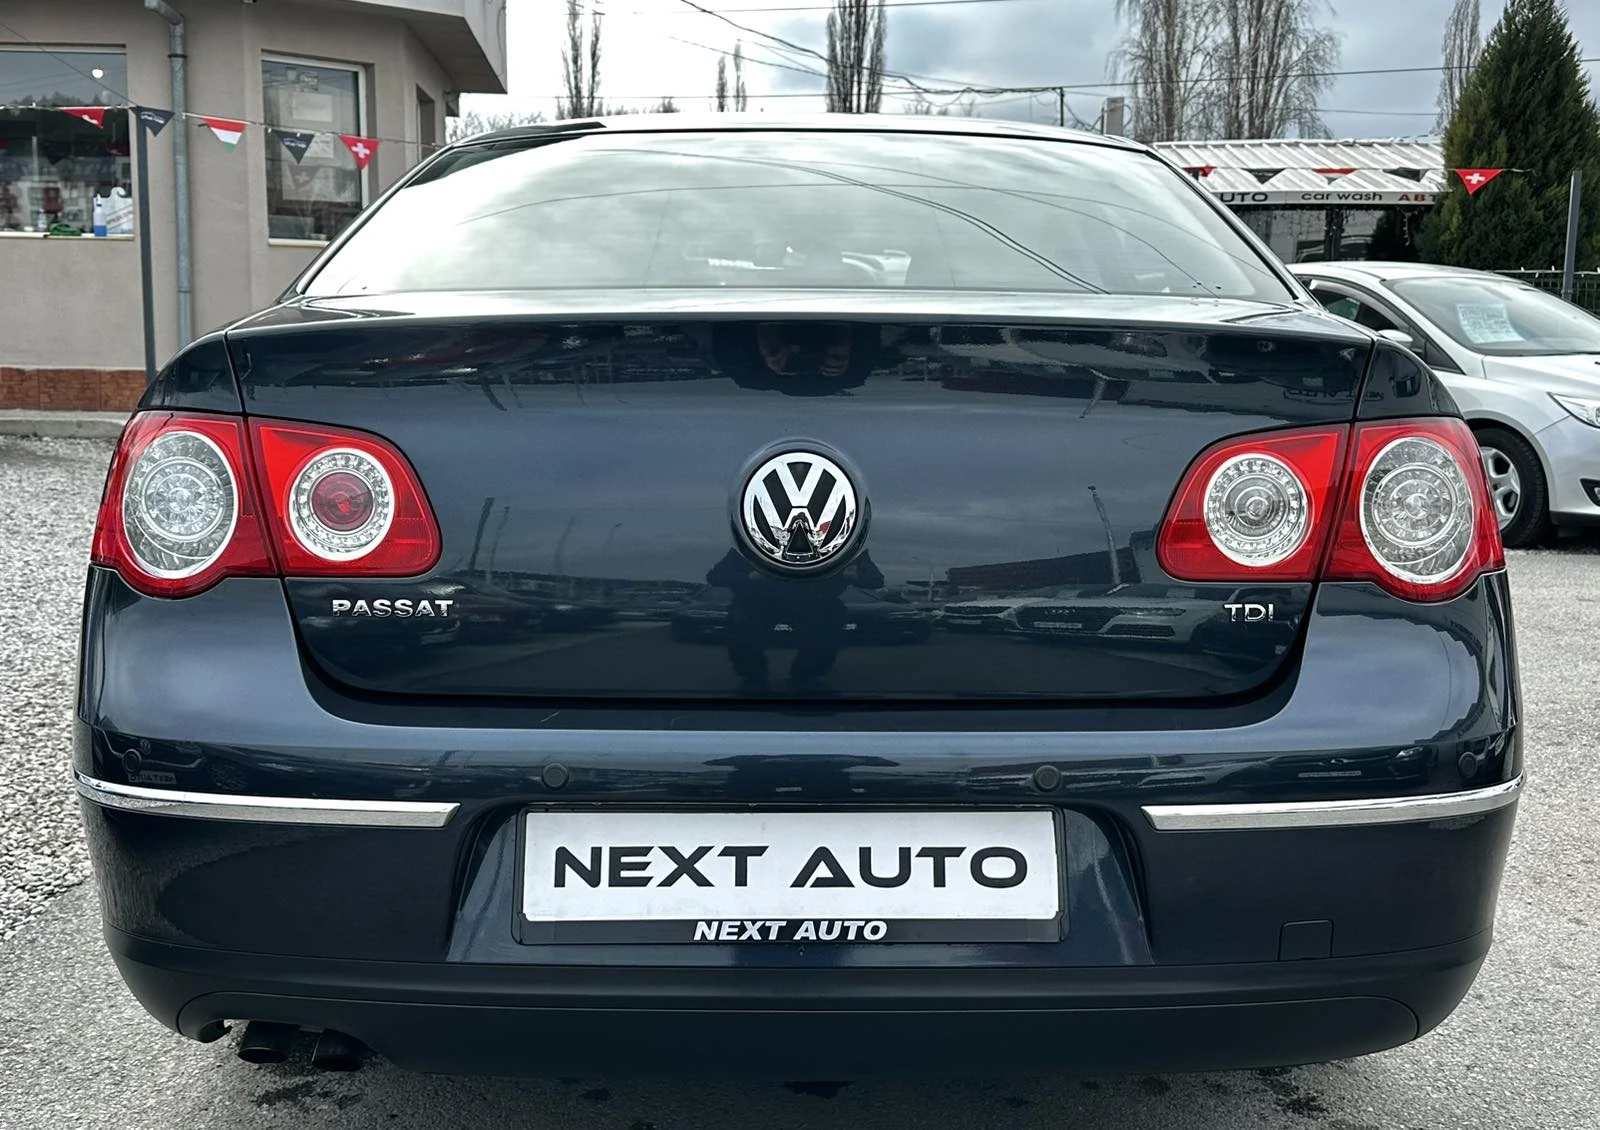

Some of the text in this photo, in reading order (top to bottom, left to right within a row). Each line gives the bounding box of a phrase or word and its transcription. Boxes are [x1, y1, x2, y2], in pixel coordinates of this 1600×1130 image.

[1301, 191, 1383, 201] car wash
[332, 599, 454, 617] PASSAT
[1223, 603, 1274, 622] TDI
[553, 845, 1028, 889] NEXT AUTO
[693, 920, 888, 941] NEXT AUTO
